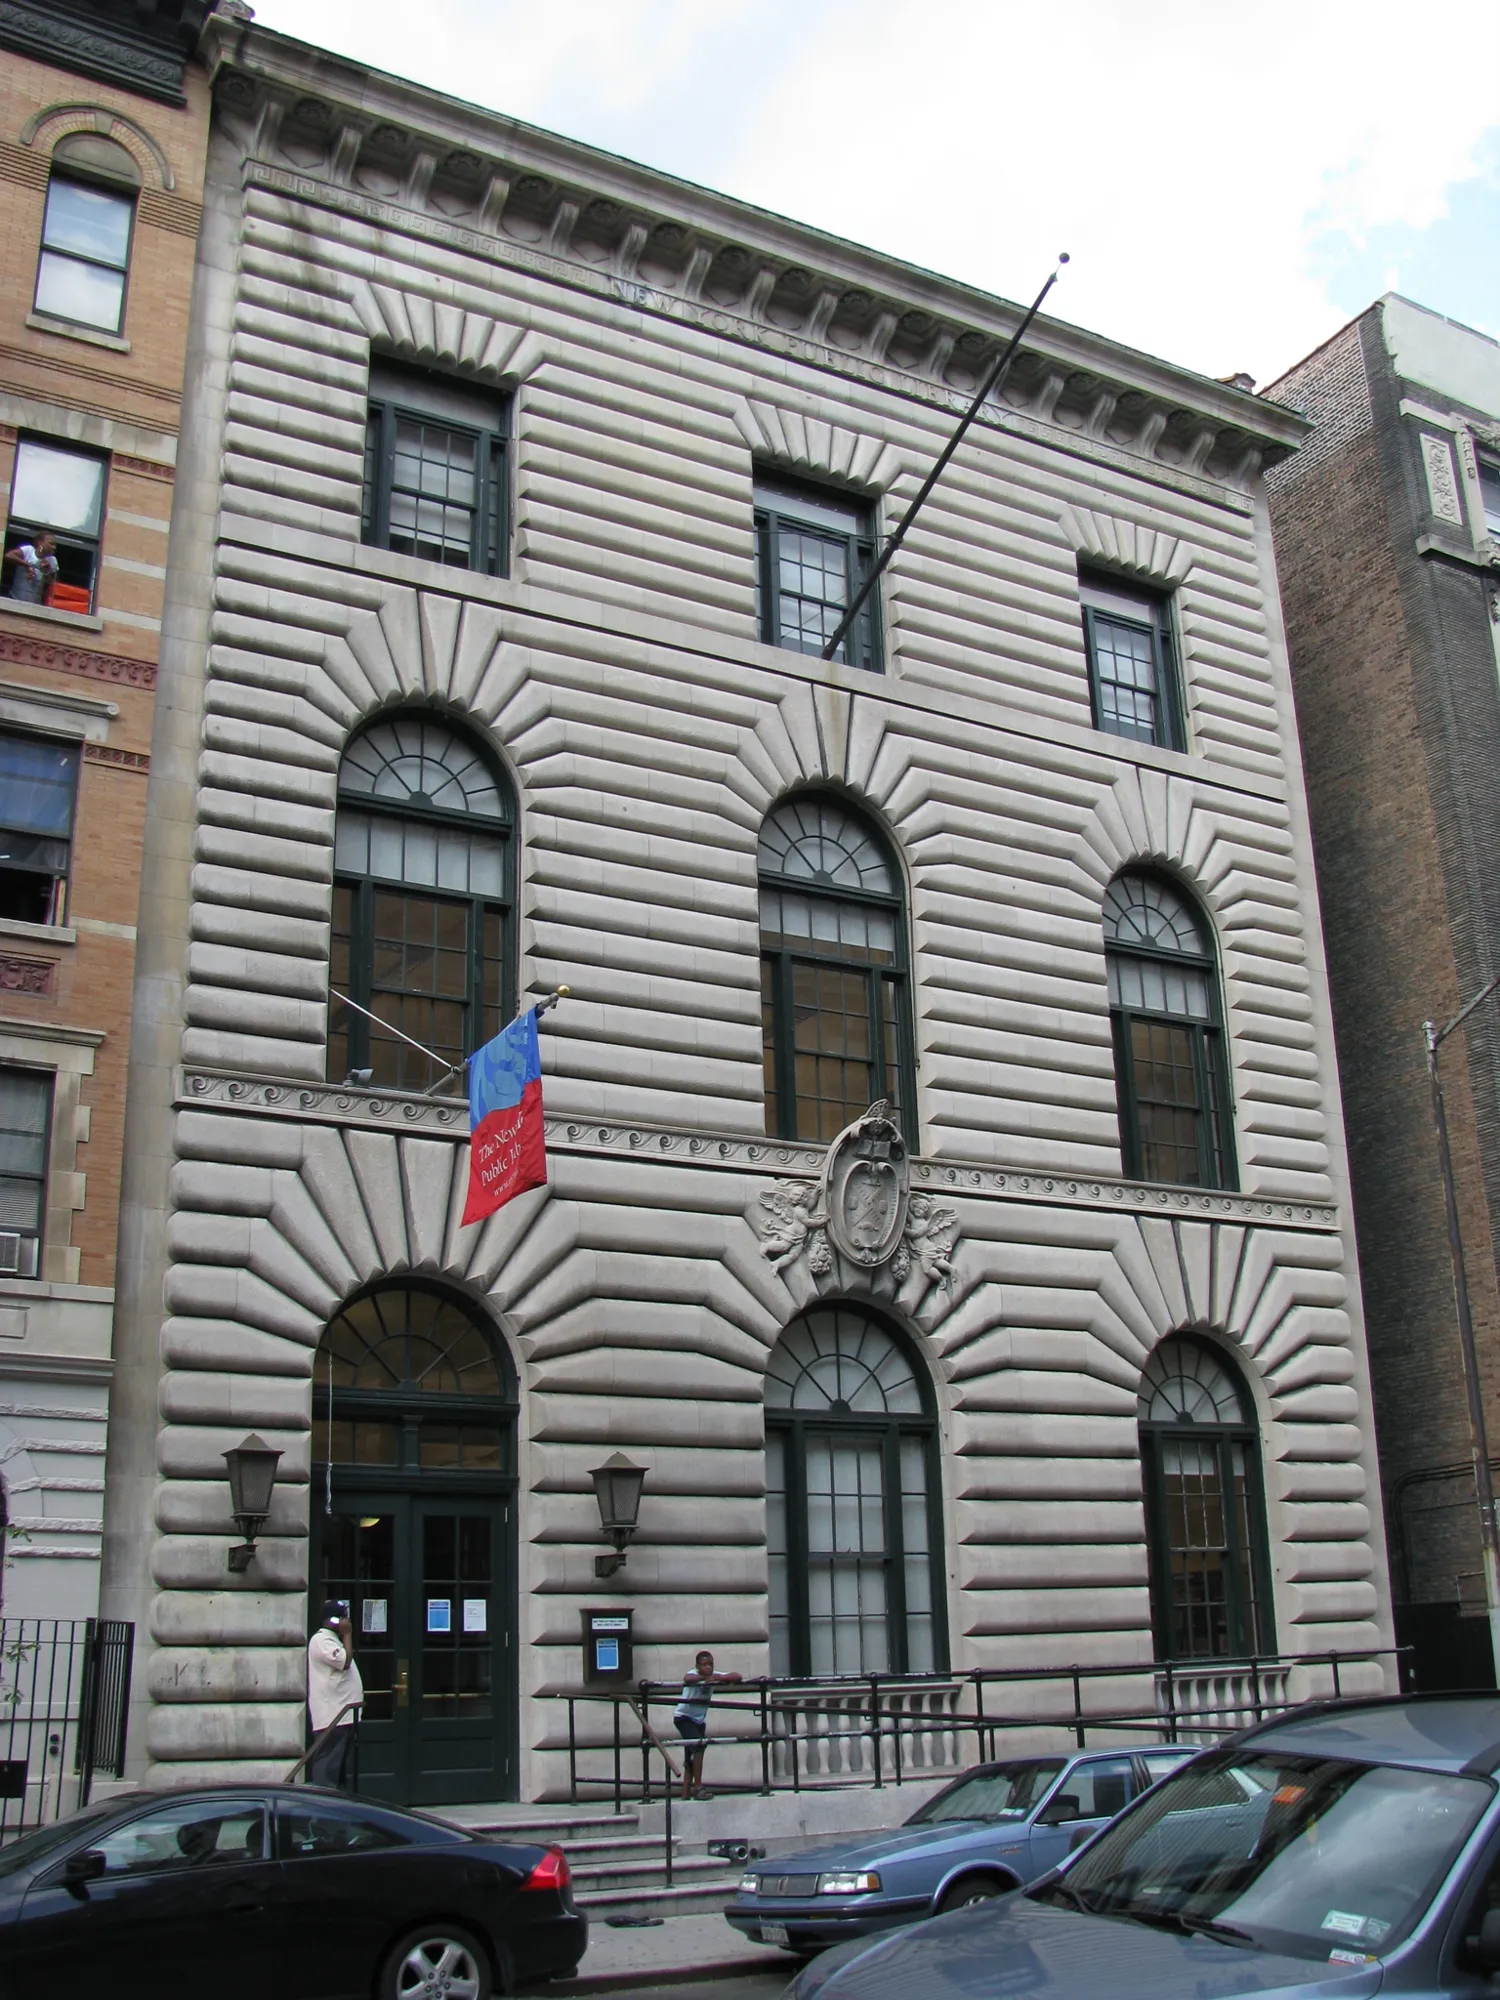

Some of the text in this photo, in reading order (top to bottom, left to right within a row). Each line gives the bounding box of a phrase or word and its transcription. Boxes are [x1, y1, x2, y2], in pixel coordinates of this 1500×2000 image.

[606, 275, 1011, 428] NEW YORK PUBLIC LIBRARY
[479, 1127, 516, 1162] The New
[481, 1157, 508, 1187] Public
